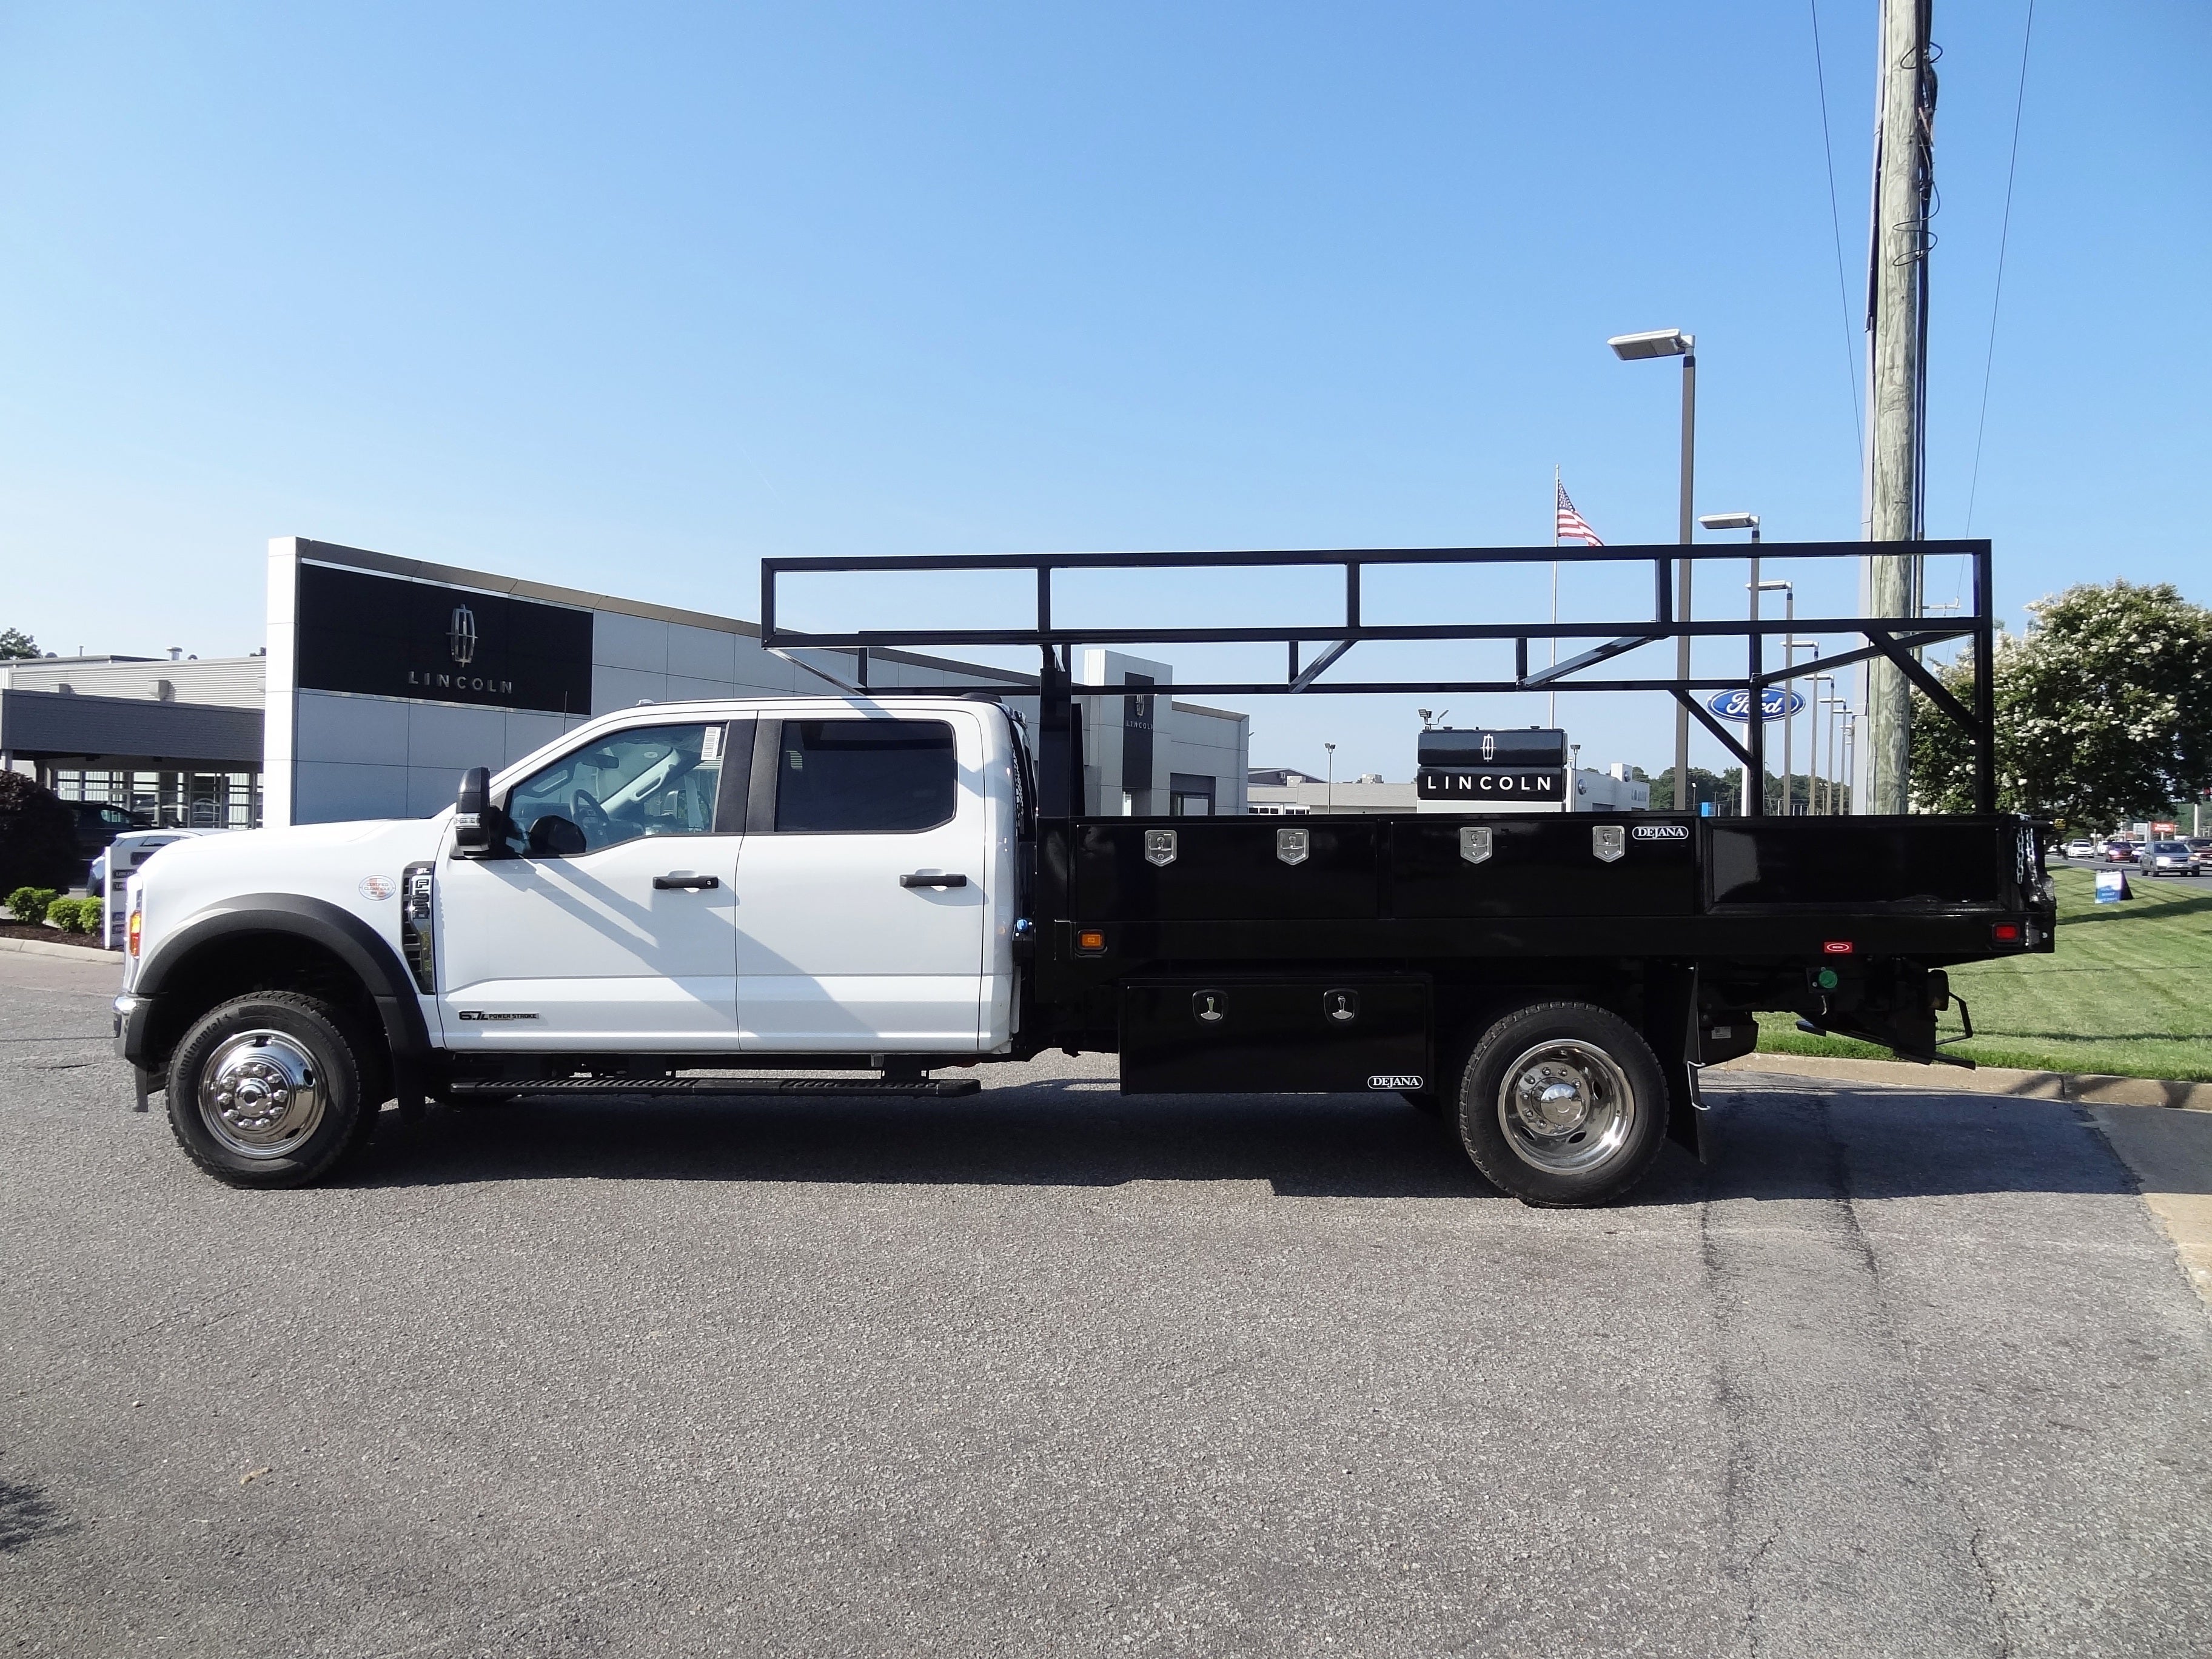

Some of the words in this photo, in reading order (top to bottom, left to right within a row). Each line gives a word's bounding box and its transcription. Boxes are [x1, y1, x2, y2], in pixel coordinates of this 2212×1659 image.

[409, 671, 512, 694] LINCOLN
[1427, 776, 1551, 791] LINCOLN
[1637, 828, 1685, 839] DEJANA
[1373, 1077, 1419, 1088] DEJANA
